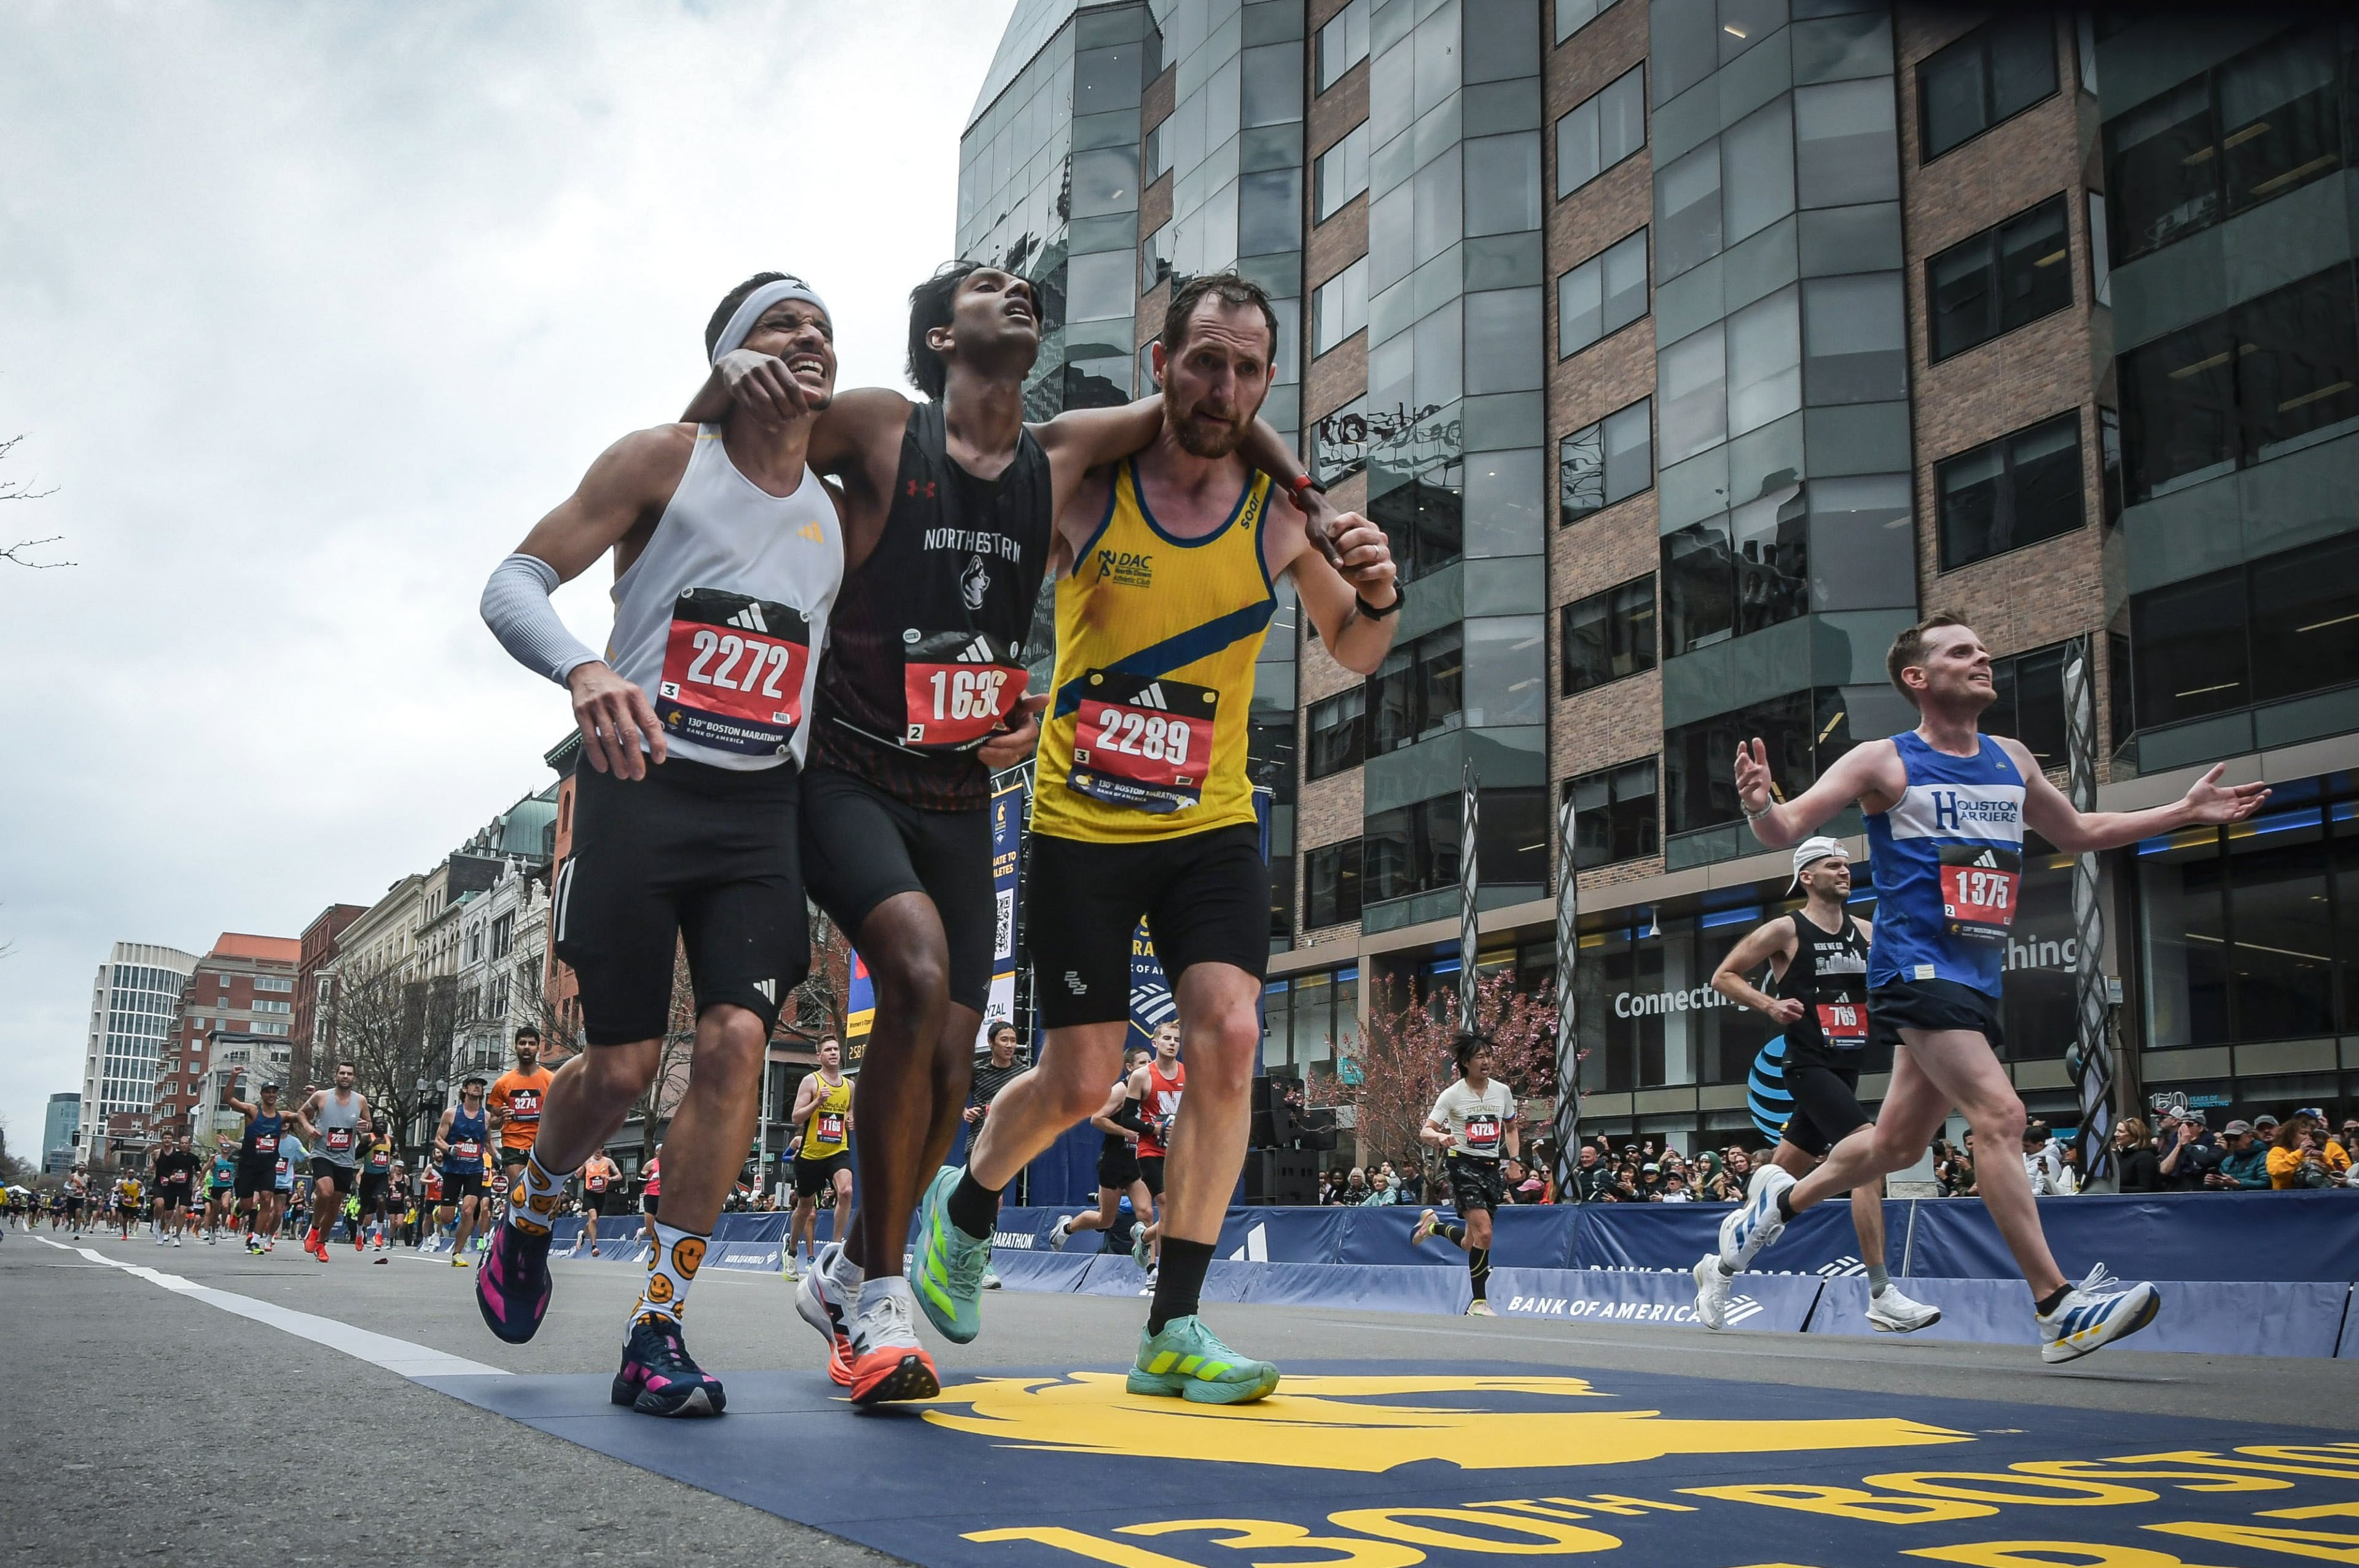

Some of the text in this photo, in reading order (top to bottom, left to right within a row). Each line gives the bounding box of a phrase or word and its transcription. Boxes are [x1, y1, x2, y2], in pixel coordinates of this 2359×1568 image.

[1241, 492, 1261, 529] soar
[687, 630, 789, 699] 2272
[664, 685, 675, 696] 3
[706, 722, 740, 735] BOSTON
[741, 729, 783, 742] MARATHON
[715, 735, 745, 744] AMERICA
[910, 727, 920, 739] 2
[1096, 709, 1191, 765] 2289
[1077, 751, 1086, 761] 3
[1114, 784, 1145, 795] BOSTON
[993, 851, 1016, 867] ATE TO
[993, 864, 1014, 878] LETES
[1956, 872, 2009, 909] 1375
[1947, 906, 1953, 915] 2
[2001, 935, 2076, 972] hing
[1136, 965, 1149, 973] OF
[1615, 983, 1750, 1018] Connecti
[1829, 1007, 1857, 1026] 769
[515, 1098, 537, 1110] 3274
[2149, 1091, 2188, 1113] 150
[1471, 1123, 1495, 1136] 4728
[1507, 1296, 1702, 1323] BANK OF AMERICA
